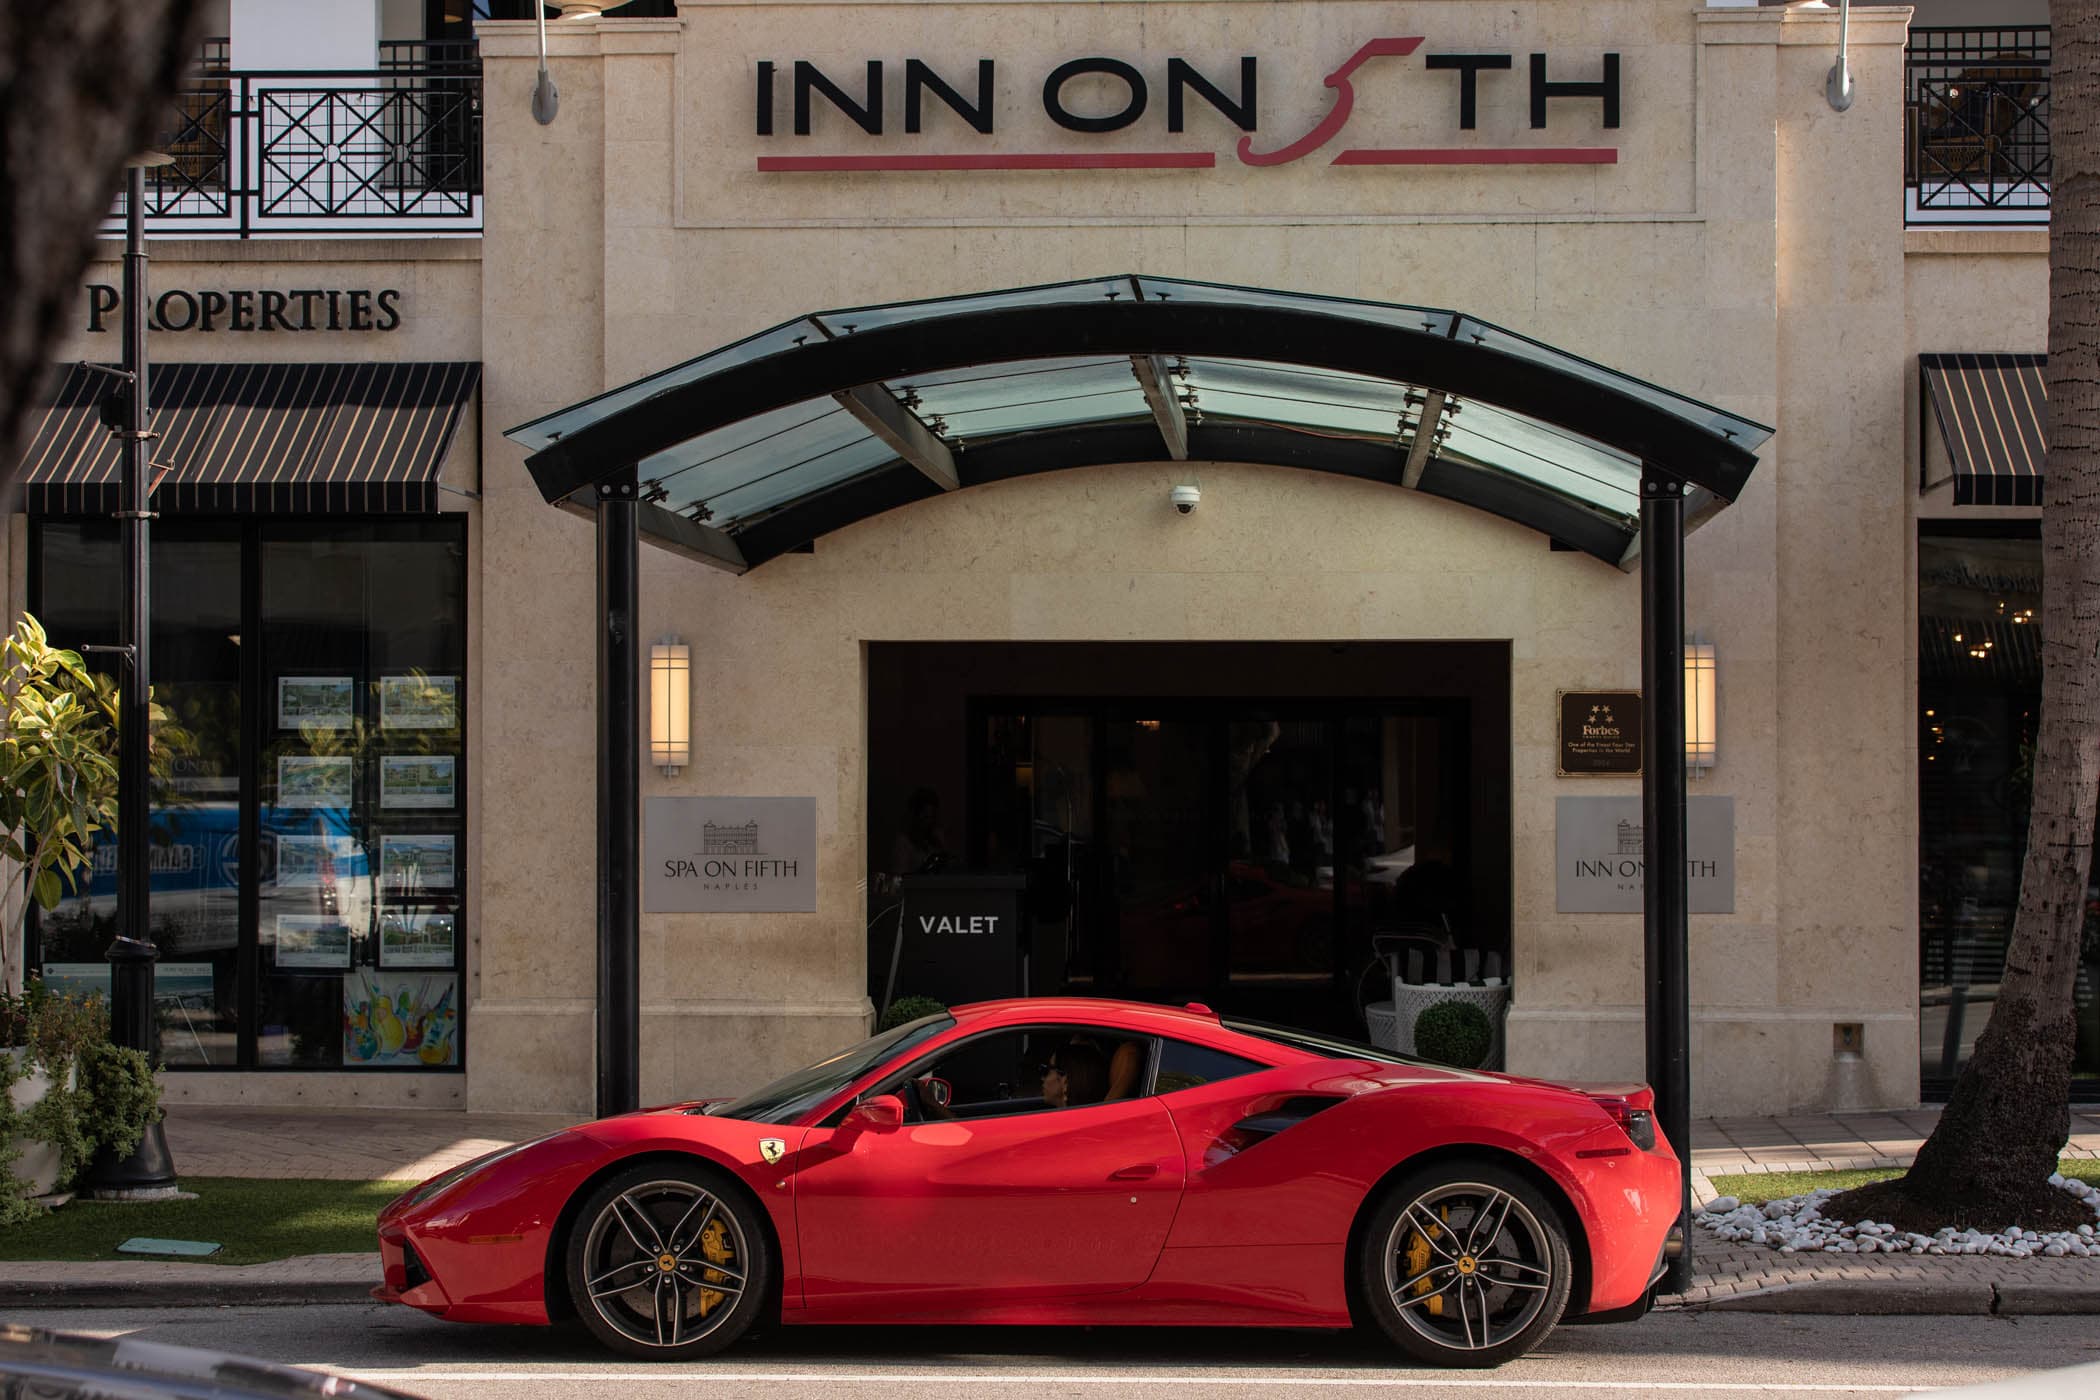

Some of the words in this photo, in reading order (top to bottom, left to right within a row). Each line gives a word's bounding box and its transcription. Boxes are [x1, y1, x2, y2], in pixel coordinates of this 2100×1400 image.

[757, 60, 994, 136] INN
[1043, 56, 1257, 134] ON
[1583, 725, 1620, 736] Forbes
[664, 860, 698, 878] SPA
[704, 860, 737, 878] ON
[745, 860, 797, 878] FIFTH
[1576, 861, 1613, 878] INN
[703, 883, 758, 891] NAPLES
[919, 916, 999, 934] VALET
